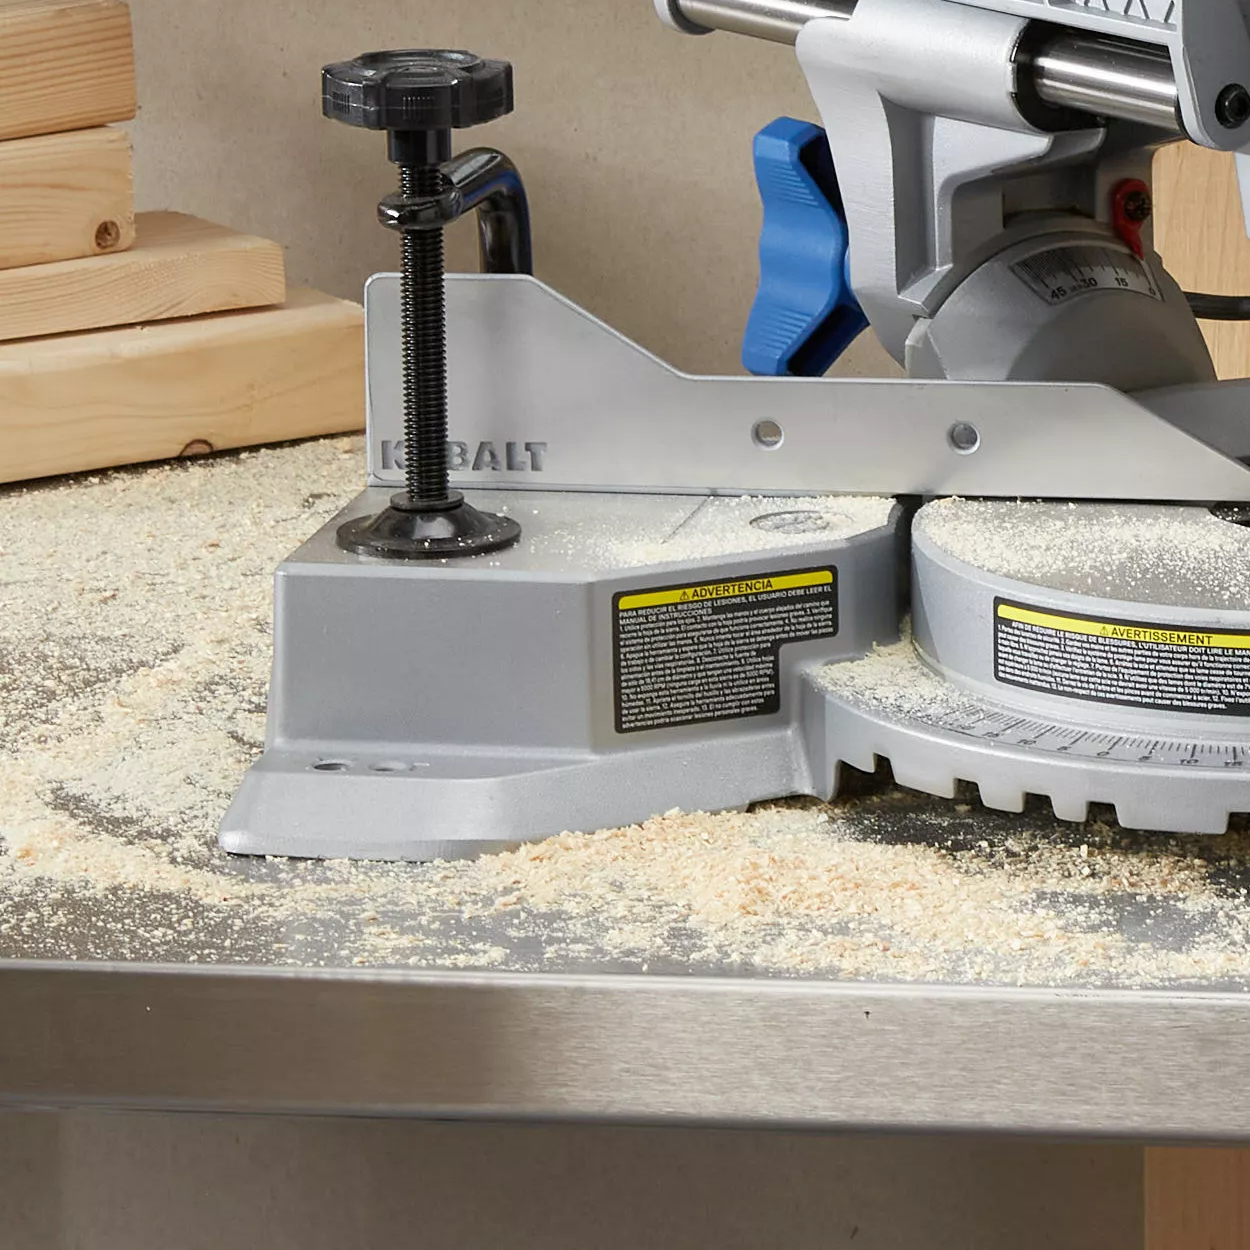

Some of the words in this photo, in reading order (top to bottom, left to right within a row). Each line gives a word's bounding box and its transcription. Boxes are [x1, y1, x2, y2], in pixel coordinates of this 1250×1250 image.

[1051, 285, 1067, 300] 45
[1080, 276, 1098, 289] 30
[1114, 276, 1129, 288] 15
[381, 440, 548, 472] KBALT
[691, 578, 774, 600] ADVERTENCIA
[1111, 627, 1213, 645] AVERTISSEMENT
[1179, 758, 1199, 766] 10
